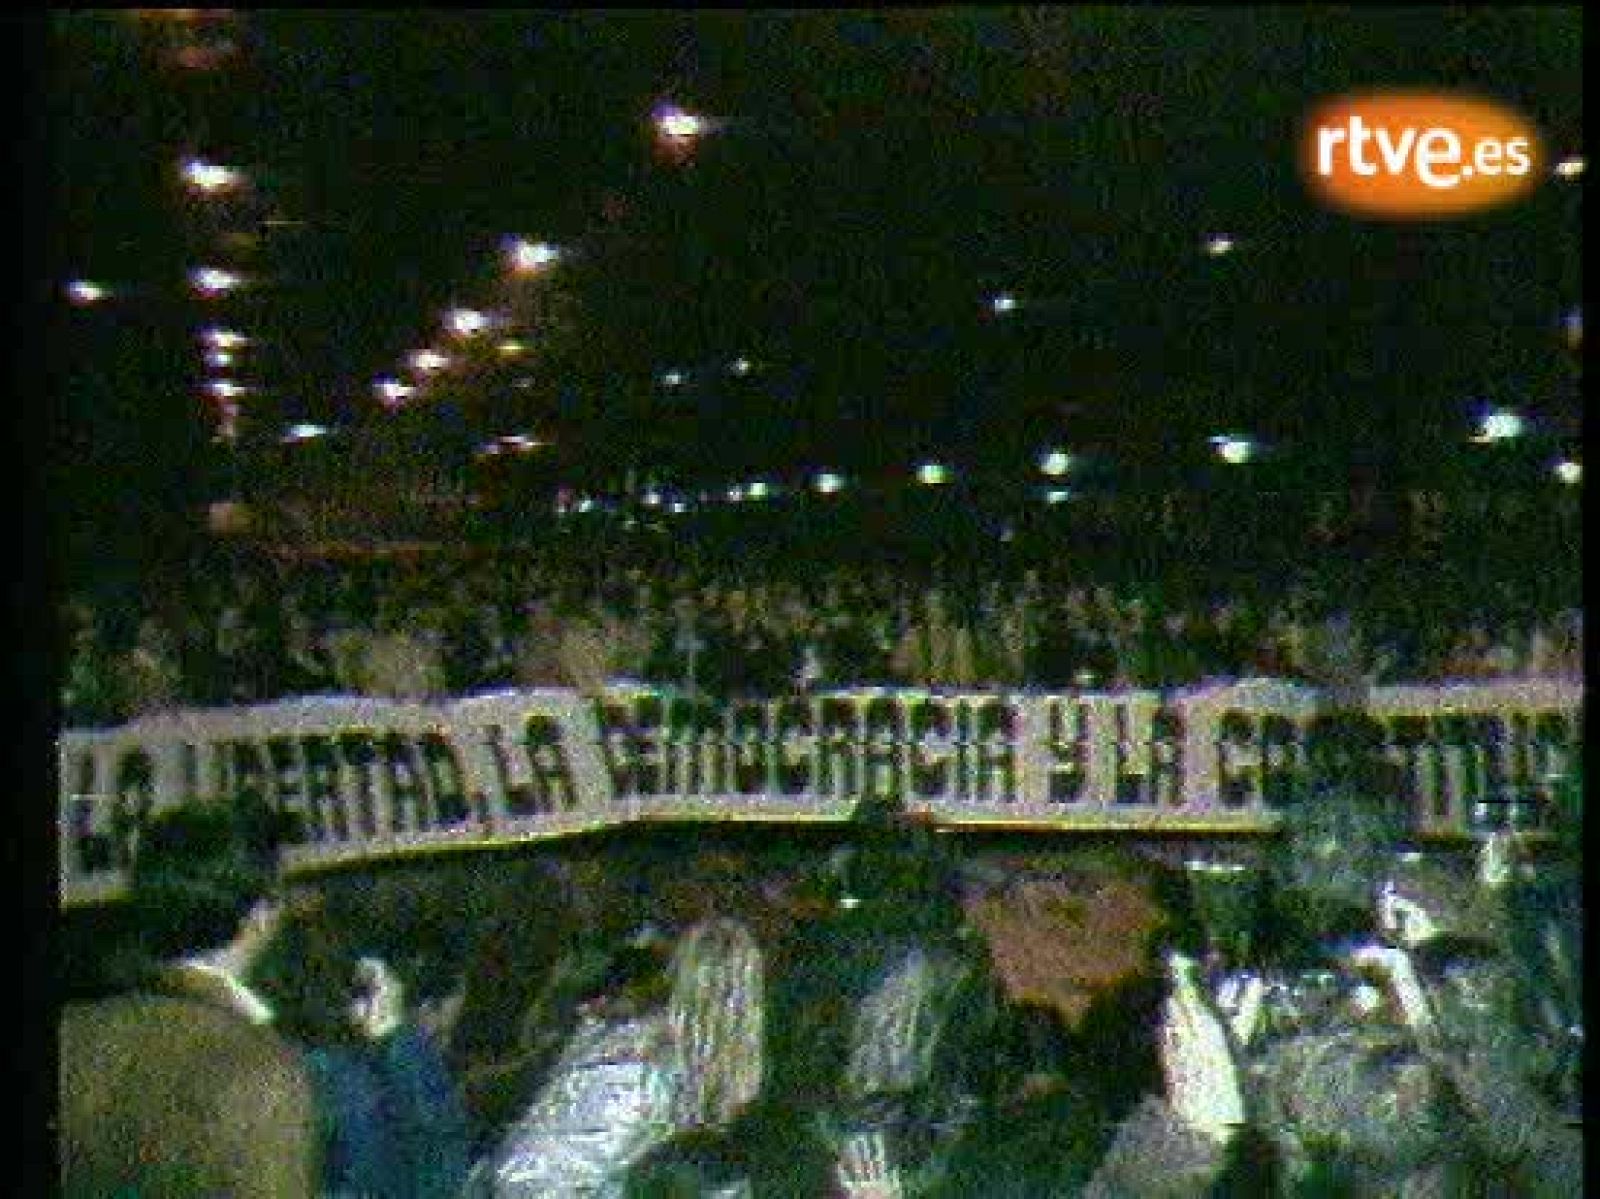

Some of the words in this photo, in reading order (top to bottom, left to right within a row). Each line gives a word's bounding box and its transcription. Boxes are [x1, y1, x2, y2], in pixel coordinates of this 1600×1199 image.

[484, 713, 577, 817] LA
[1048, 700, 1091, 804] Y
[1114, 701, 1185, 806] LA
